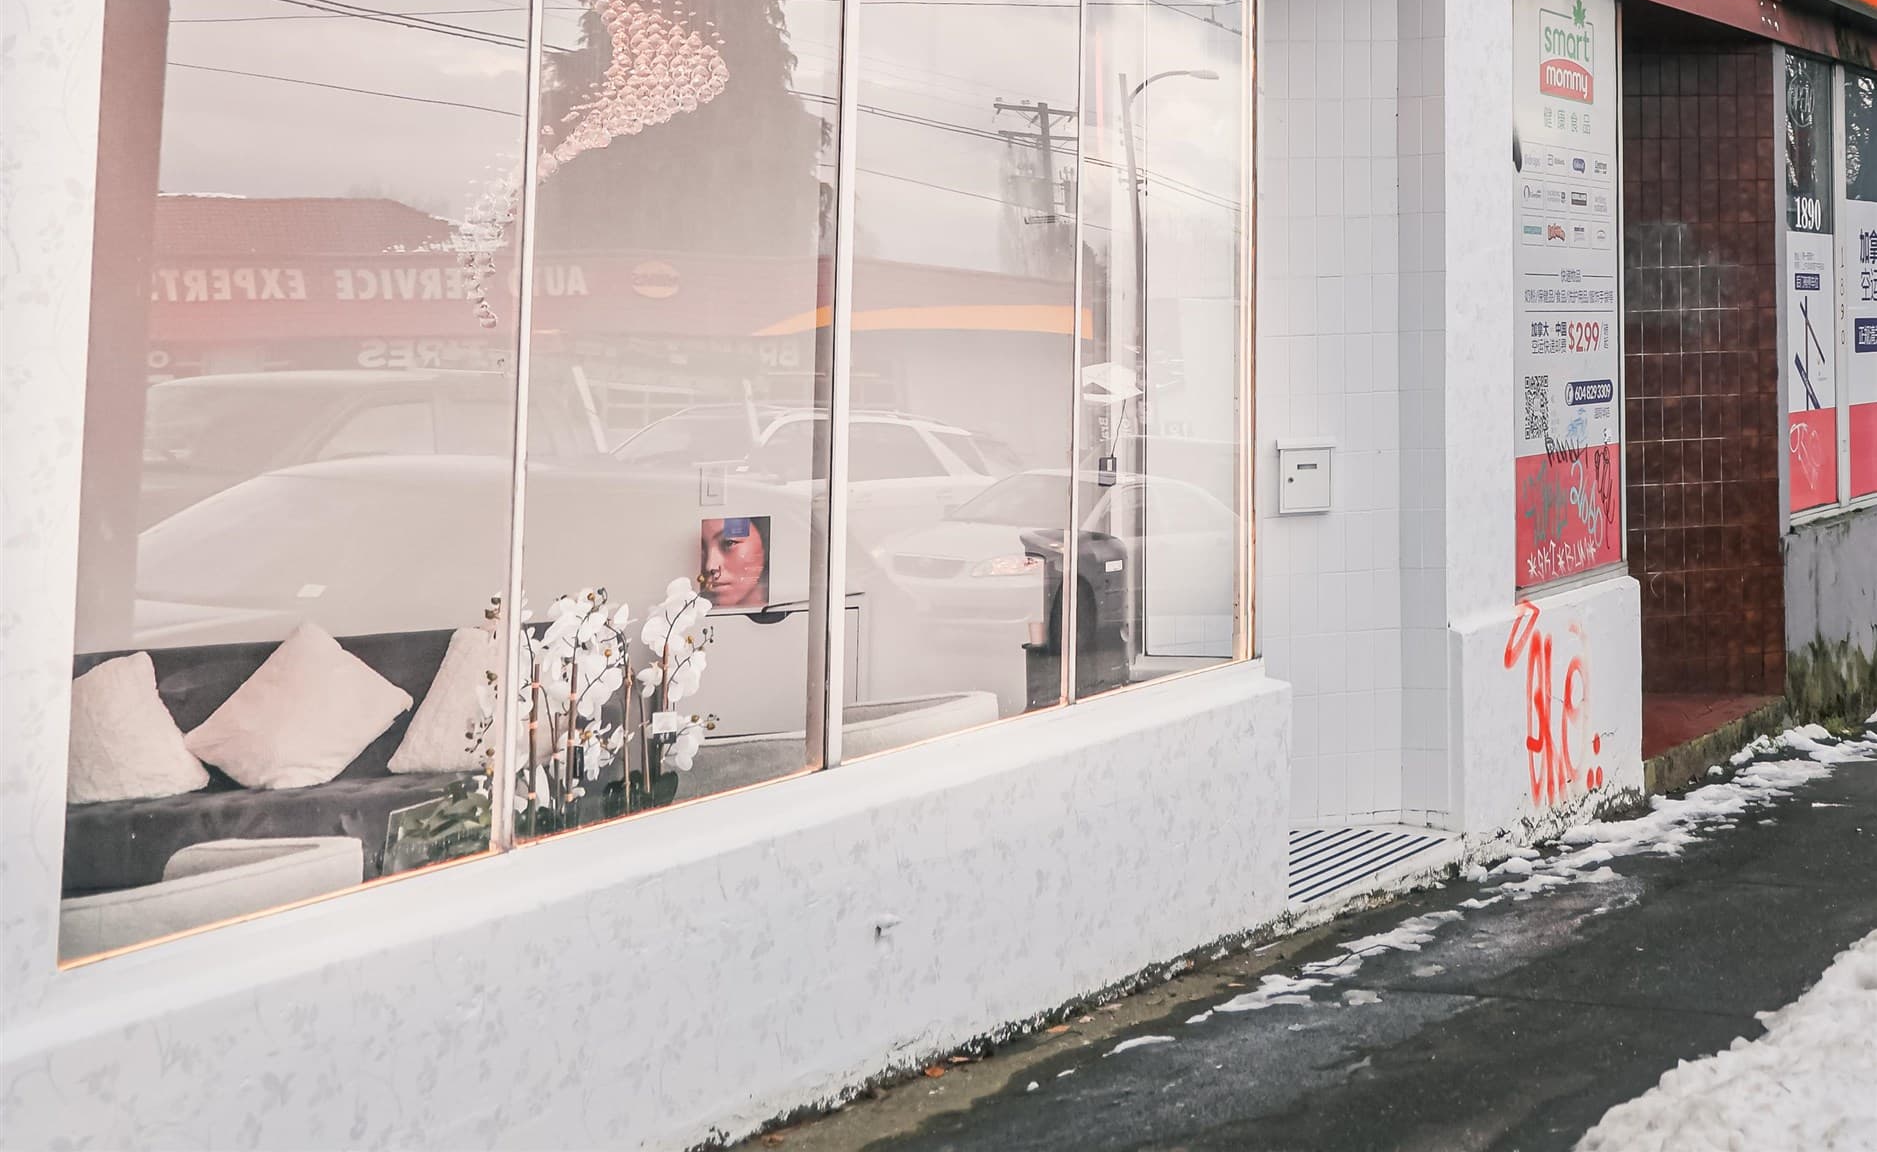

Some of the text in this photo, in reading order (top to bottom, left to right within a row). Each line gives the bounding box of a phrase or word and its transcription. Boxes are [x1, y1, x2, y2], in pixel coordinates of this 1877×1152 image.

[1544, 26, 1590, 63] smart
[1546, 65, 1588, 99] mommy
[1794, 196, 1821, 231] 1890
[1568, 320, 1600, 353] $2.99
